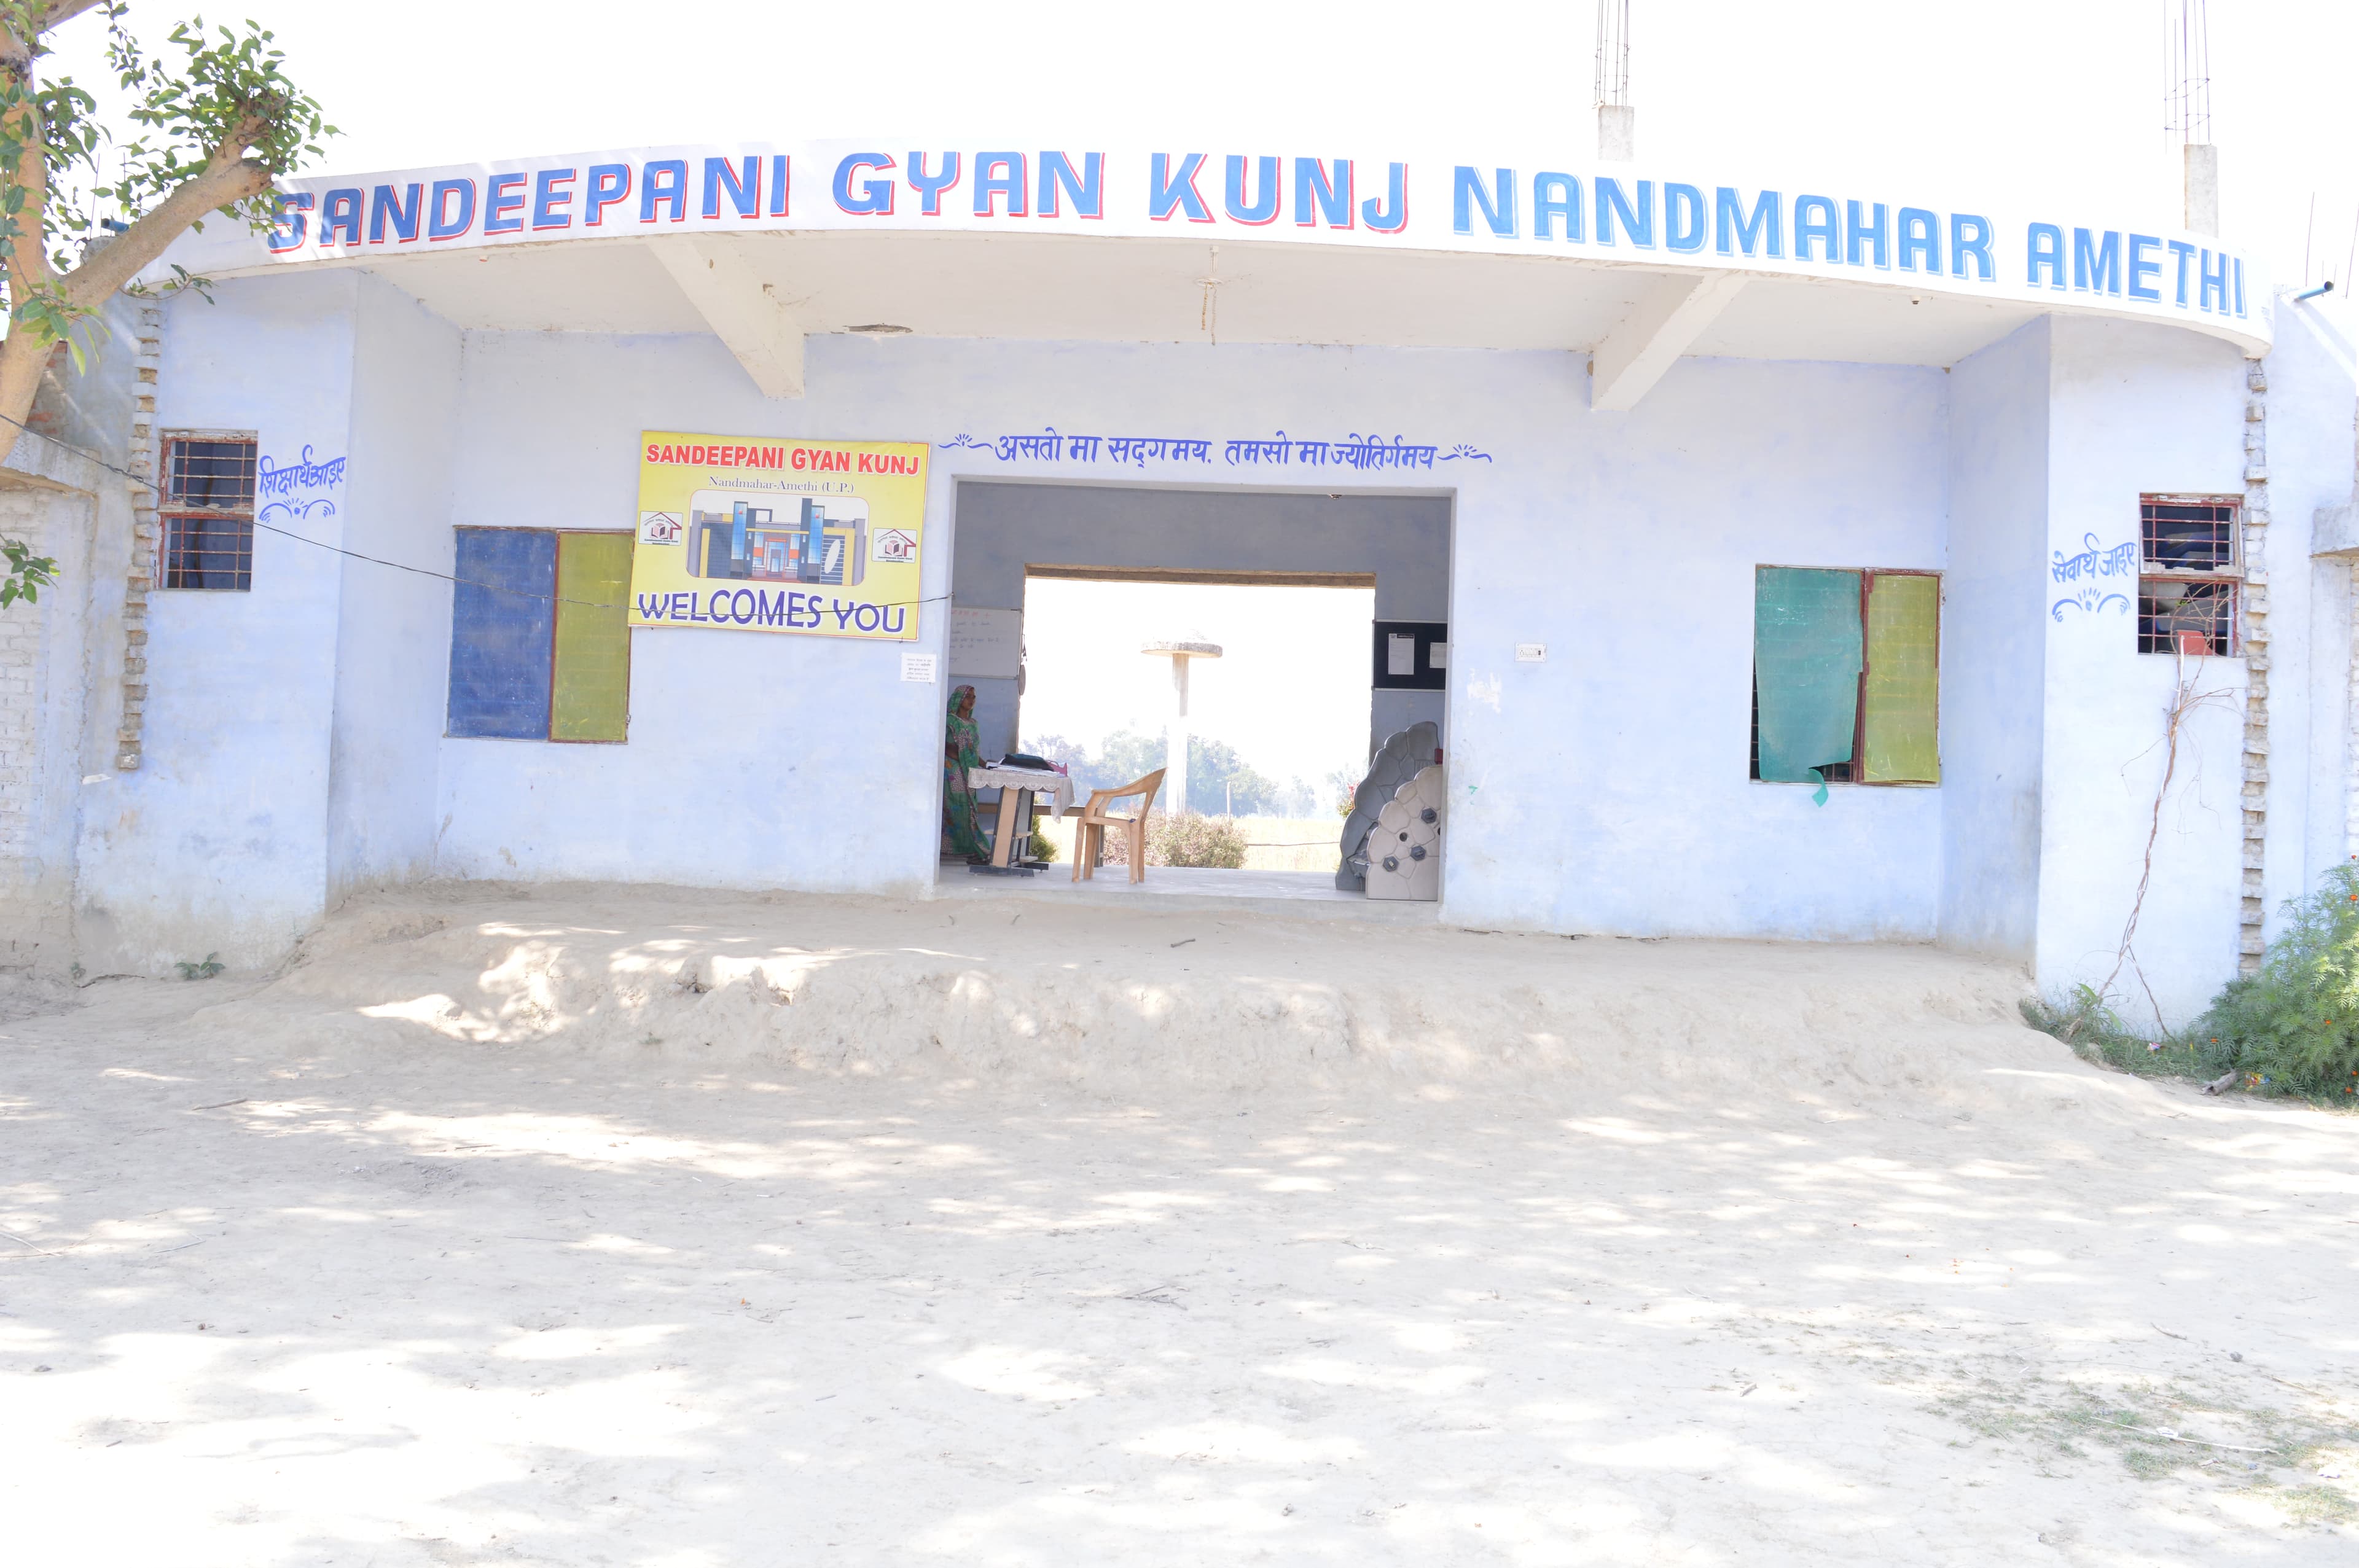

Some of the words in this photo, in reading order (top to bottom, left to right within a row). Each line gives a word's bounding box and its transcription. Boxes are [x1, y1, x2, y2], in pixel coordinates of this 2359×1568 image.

[268, 154, 790, 254] SANDEEPANI
[832, 151, 1105, 219] GYAN
[1149, 152, 1409, 234] KUNJ
[1453, 165, 1997, 282] NANDMAHAR
[2027, 221, 2248, 319] AMETHI
[646, 443, 784, 469] SANDEEPANI
[791, 448, 851, 472] GYAN
[858, 453, 920, 476] KUNJ
[995, 427, 1063, 461] असतो
[1068, 435, 1103, 462] मा
[1225, 430, 1294, 466] तमसो
[1296, 440, 1331, 466] मा
[1331, 432, 1438, 470] ज्योतिर्गमय
[708, 475, 818, 491] Nandmahar-Amethi
[821, 482, 855, 493] (U.P.)
[638, 588, 823, 629] WELCOMES
[833, 598, 905, 633] YOU
